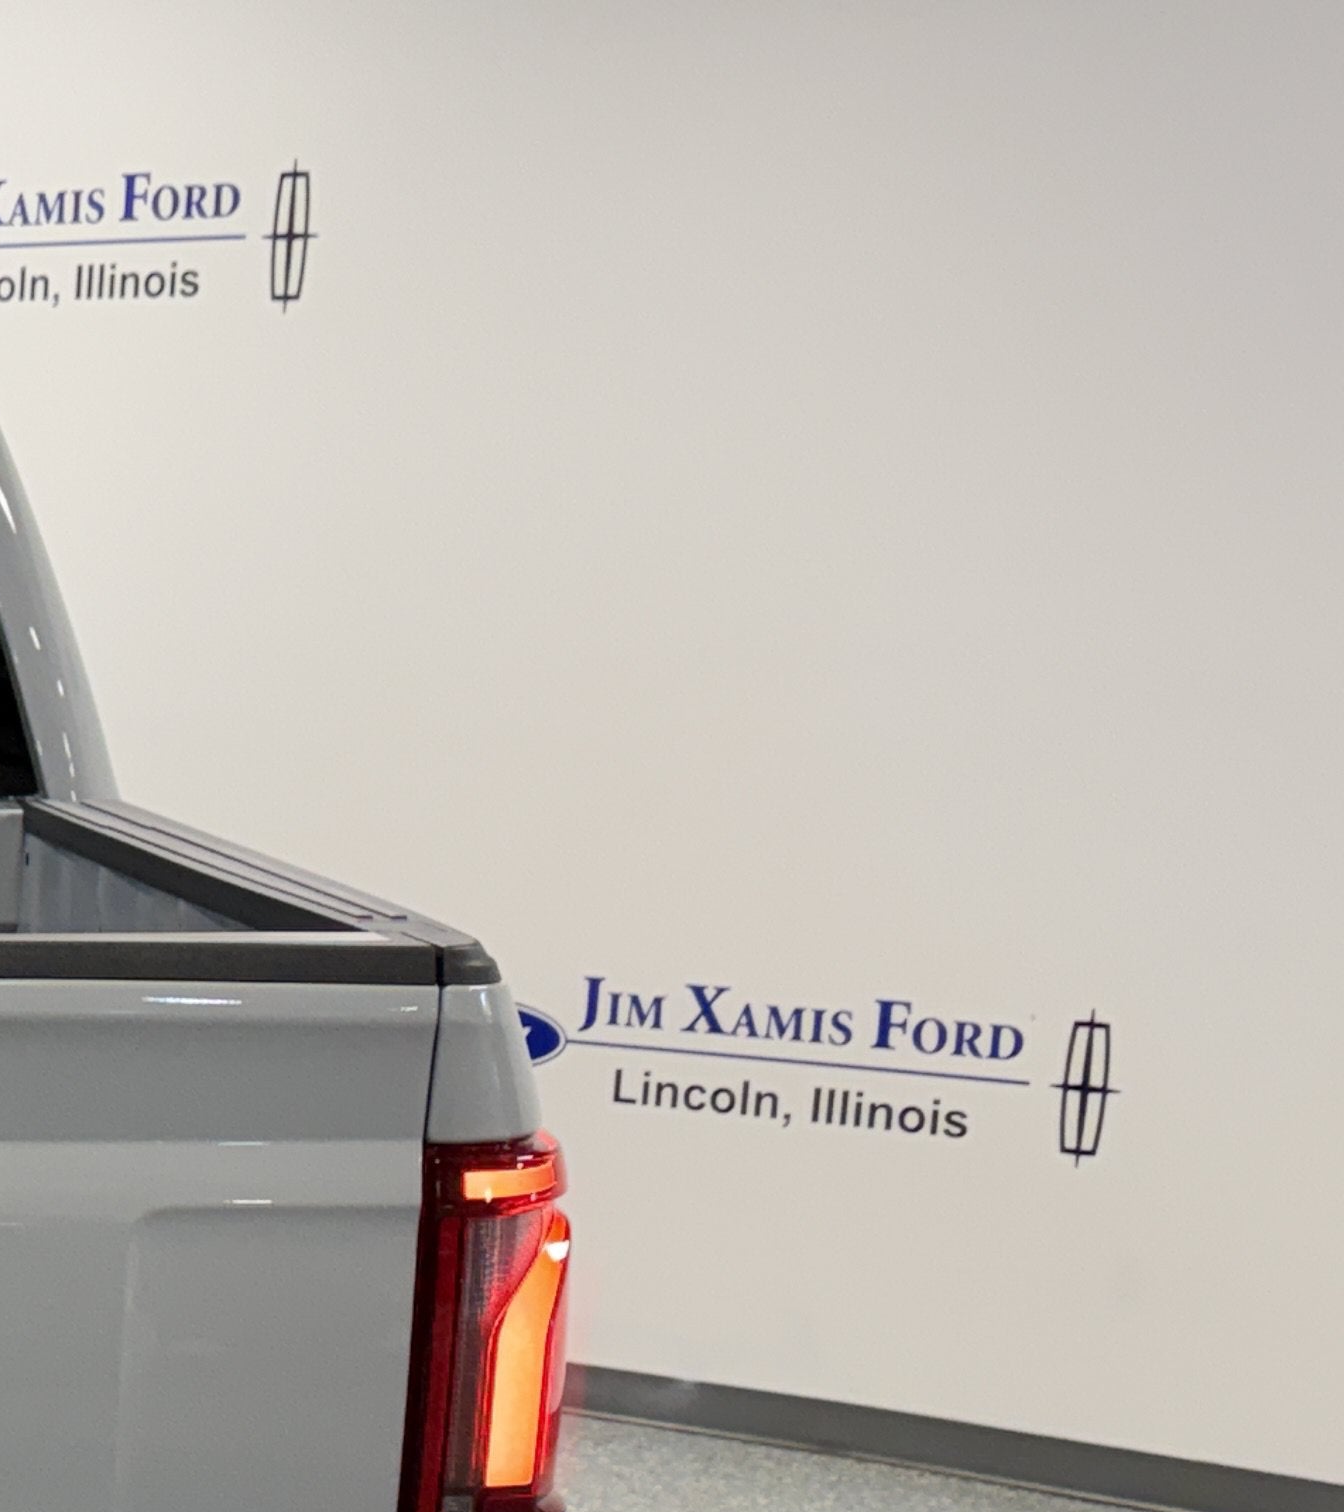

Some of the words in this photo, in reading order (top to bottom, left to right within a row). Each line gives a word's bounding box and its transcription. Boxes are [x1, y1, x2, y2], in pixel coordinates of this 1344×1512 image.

[119, 172, 241, 222] FORD
[75, 261, 199, 300] Illinois
[577, 975, 665, 1033] JIM
[679, 984, 854, 1046] XAMIS
[870, 998, 1025, 1061] FORD
[611, 1068, 793, 1129] Lincoln,
[809, 1086, 969, 1140] Illinois
